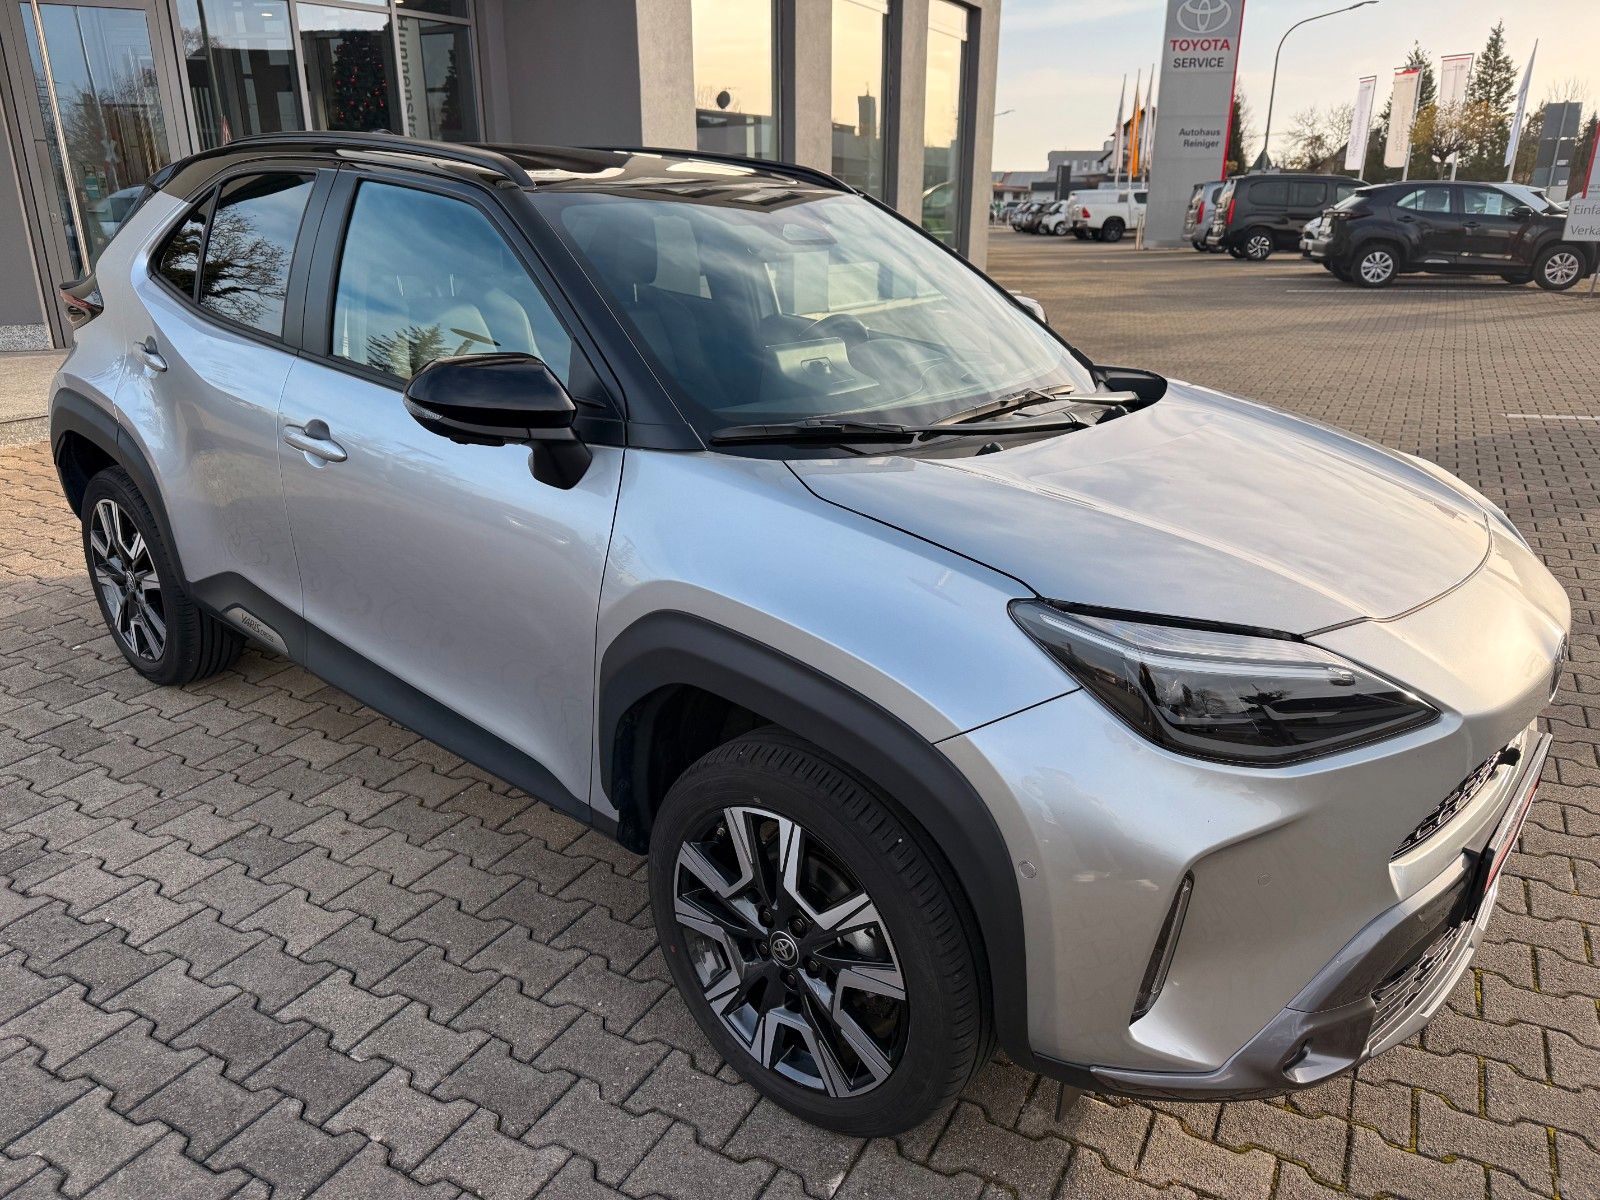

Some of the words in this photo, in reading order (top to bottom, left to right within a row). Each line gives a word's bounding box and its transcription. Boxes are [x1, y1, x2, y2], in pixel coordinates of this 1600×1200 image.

[1170, 39, 1231, 52] TOYOTA
[1173, 57, 1225, 68] SERVICE
[1179, 128, 1221, 136] Autohaus
[1183, 139, 1219, 149] Reiniger
